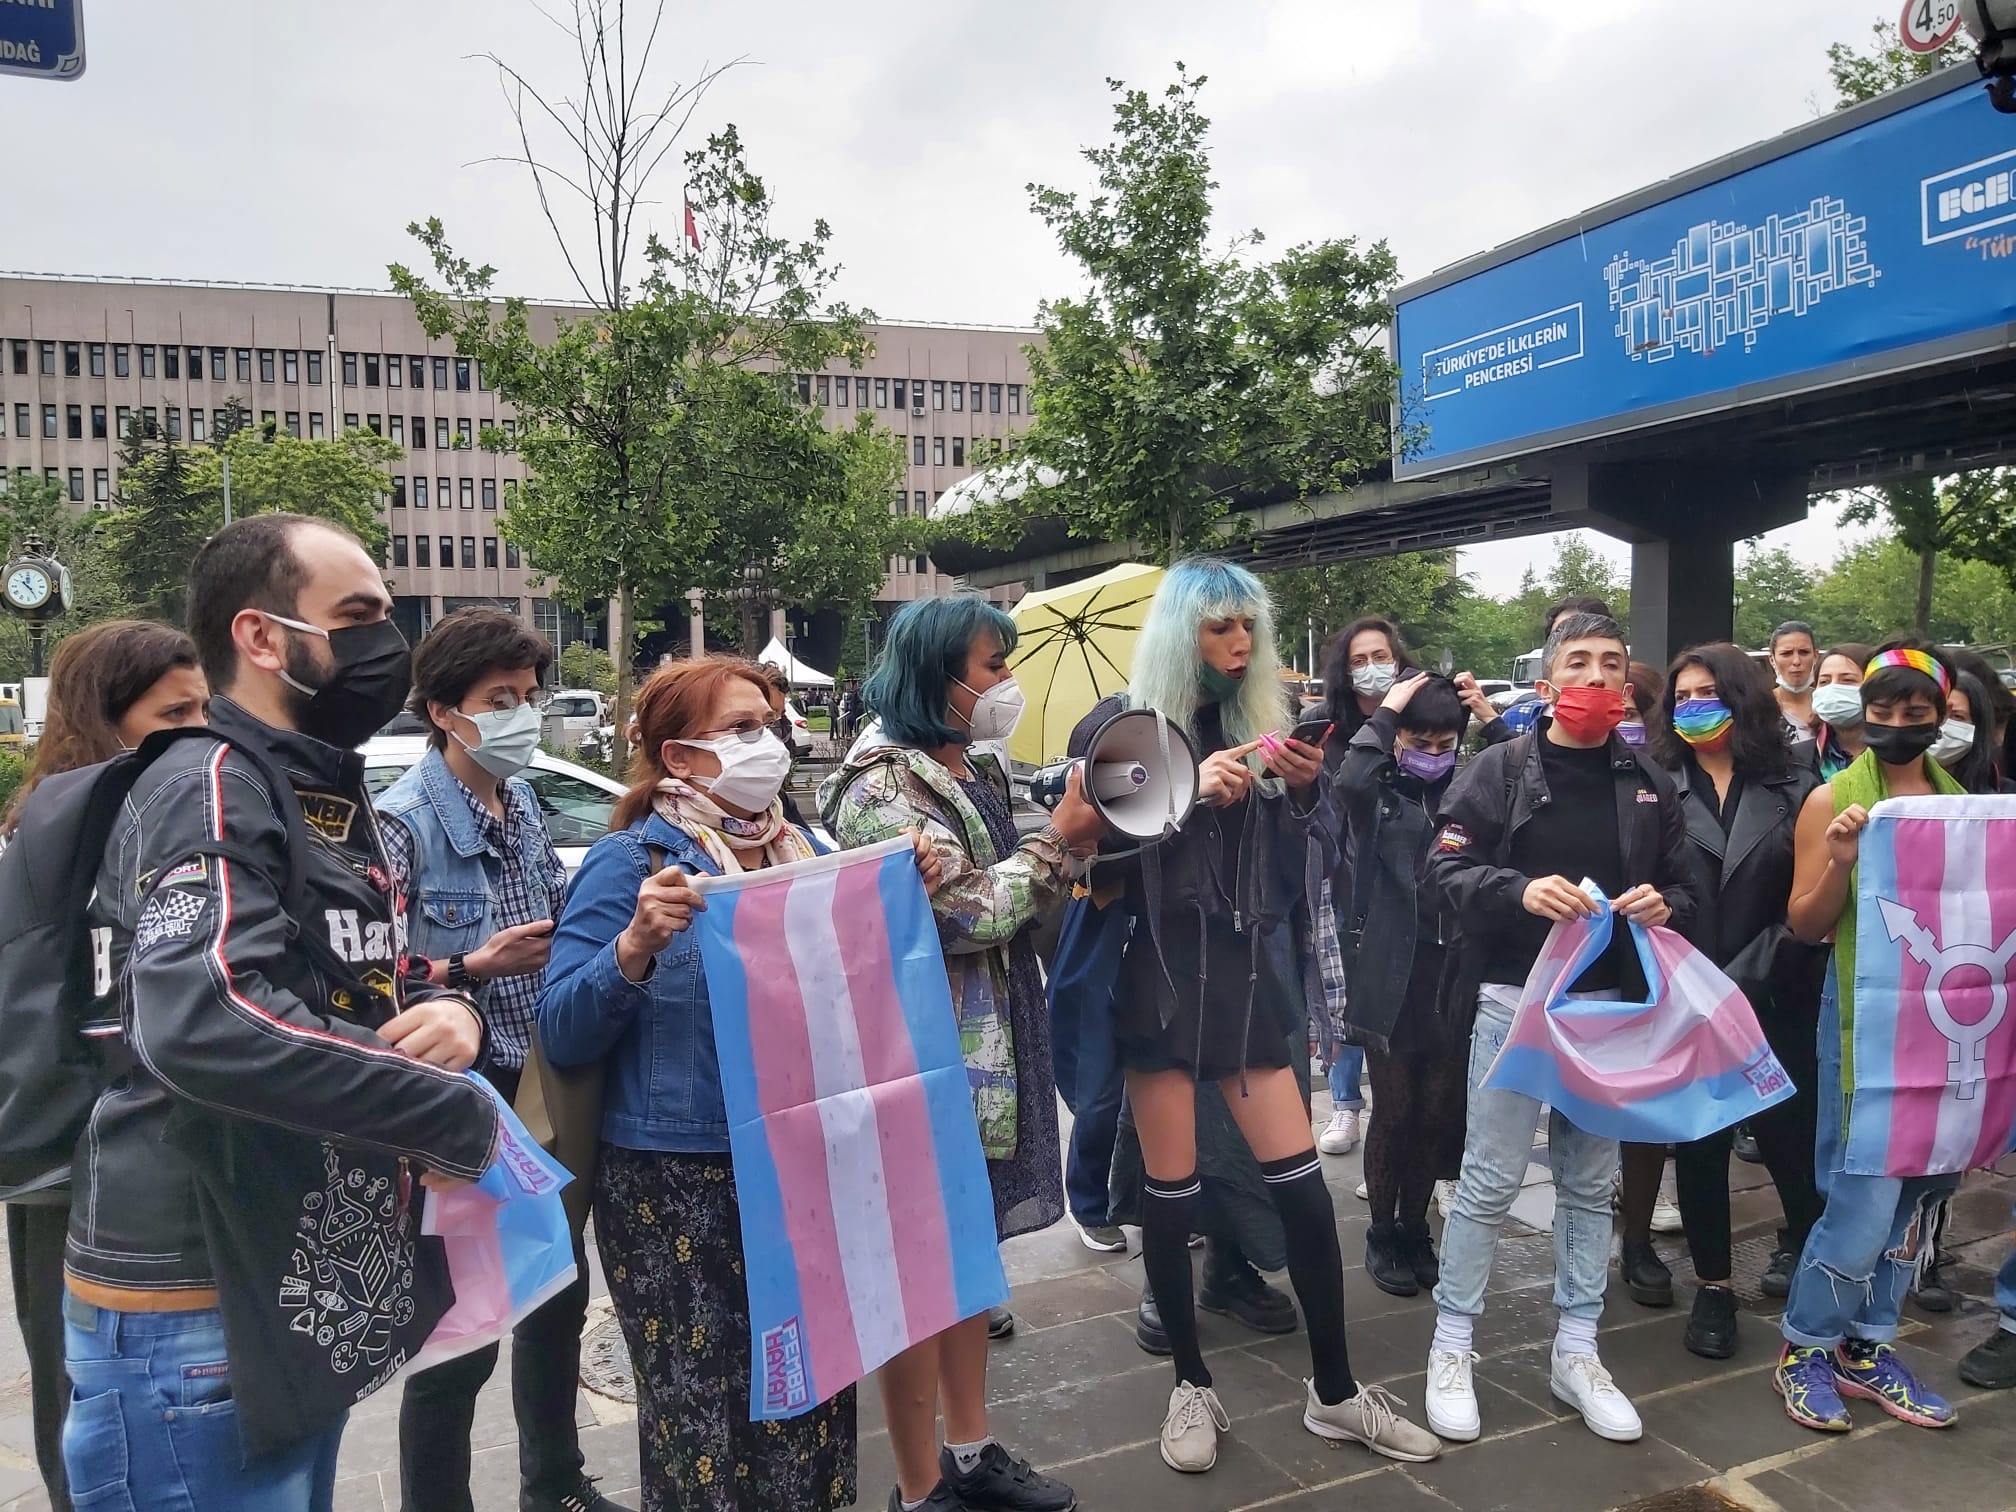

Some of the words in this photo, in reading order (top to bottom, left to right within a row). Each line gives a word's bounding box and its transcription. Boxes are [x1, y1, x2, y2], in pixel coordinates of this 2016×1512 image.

[1938, 169, 2016, 223] EGE
[1507, 322, 1568, 355] İLKLERİN
[1464, 352, 1533, 390] PENCERESİ
[766, 1330, 788, 1407] HAYAT
[782, 1321, 807, 1405] PEMBE
